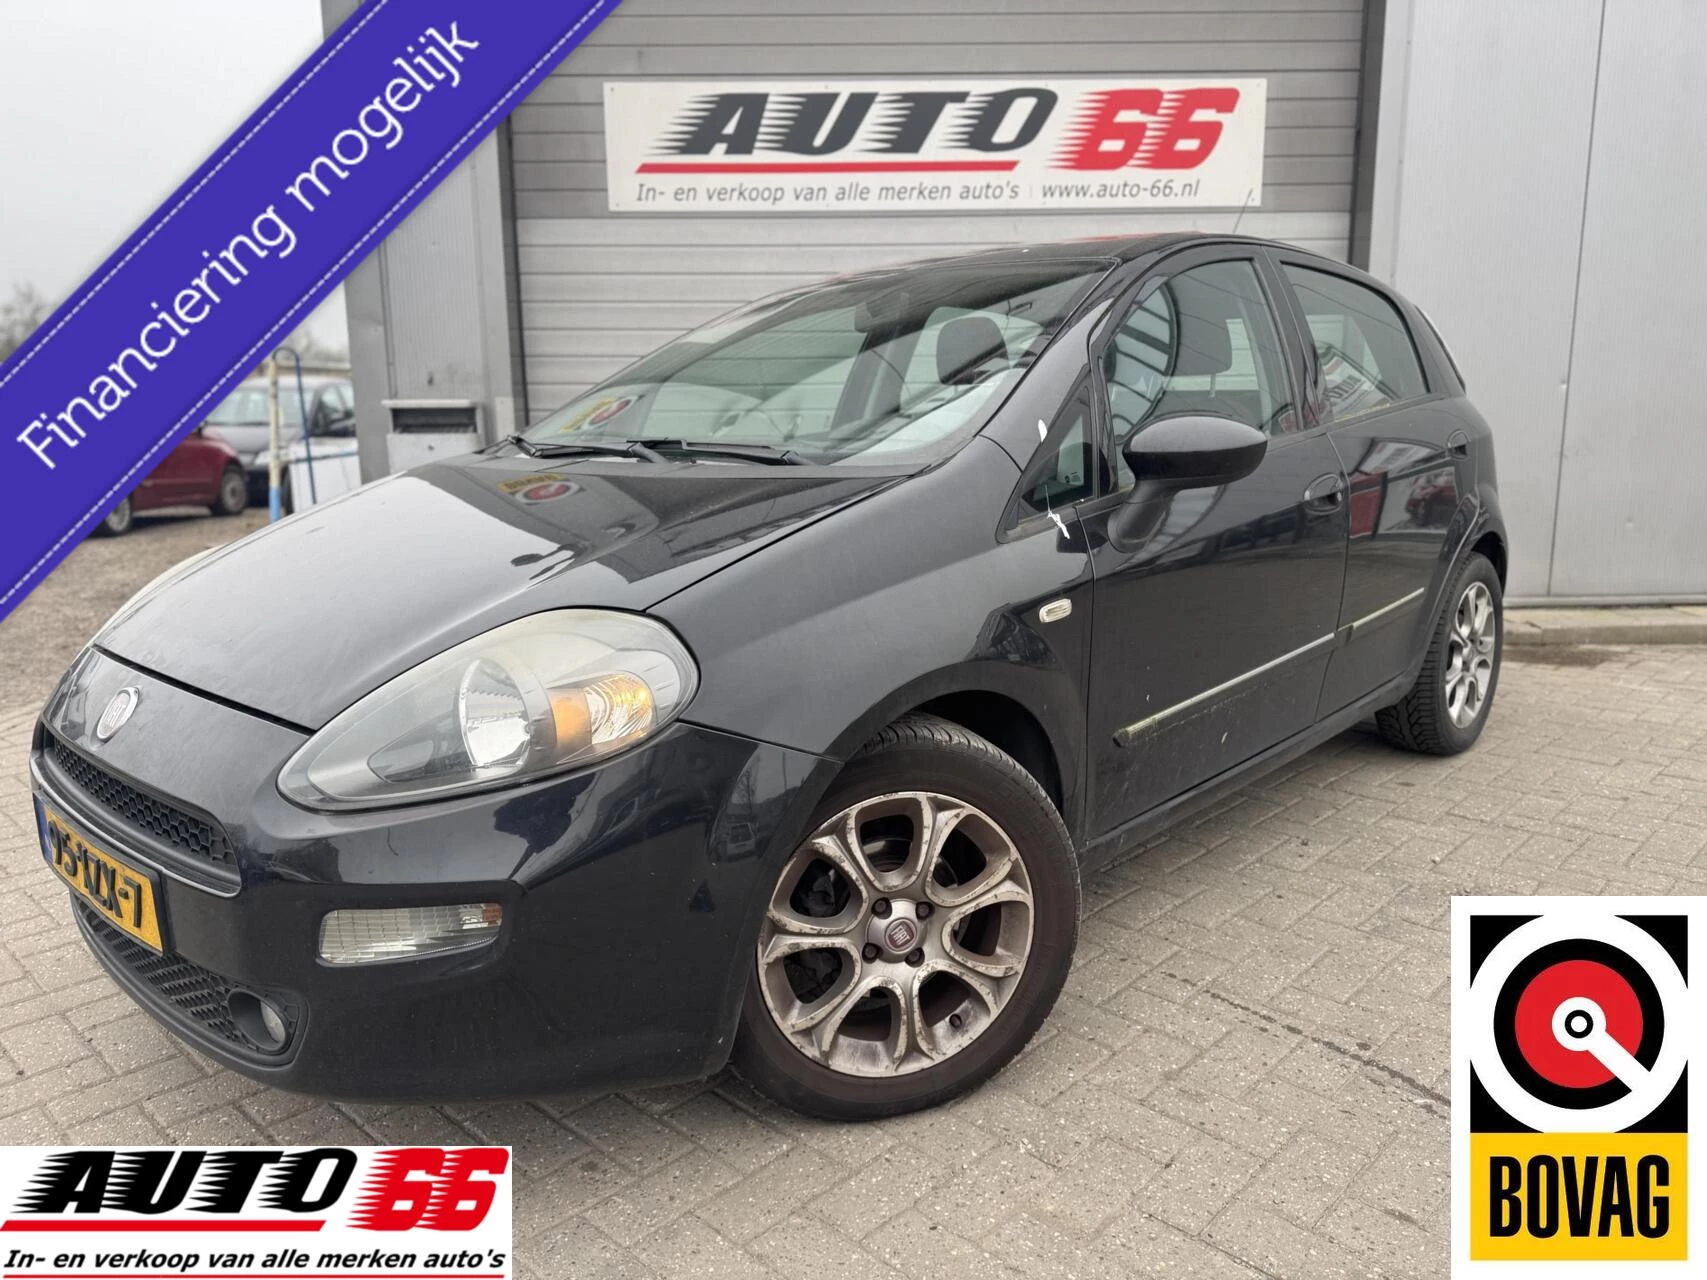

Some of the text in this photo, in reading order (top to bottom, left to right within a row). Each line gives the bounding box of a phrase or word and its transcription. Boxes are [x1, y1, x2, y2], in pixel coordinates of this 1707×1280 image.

[643, 86, 1241, 172] AUTO 66
[636, 182, 1019, 205] In- en verkoop van alle merken auto's
[1041, 179, 1201, 198] www.auto-66.nl
